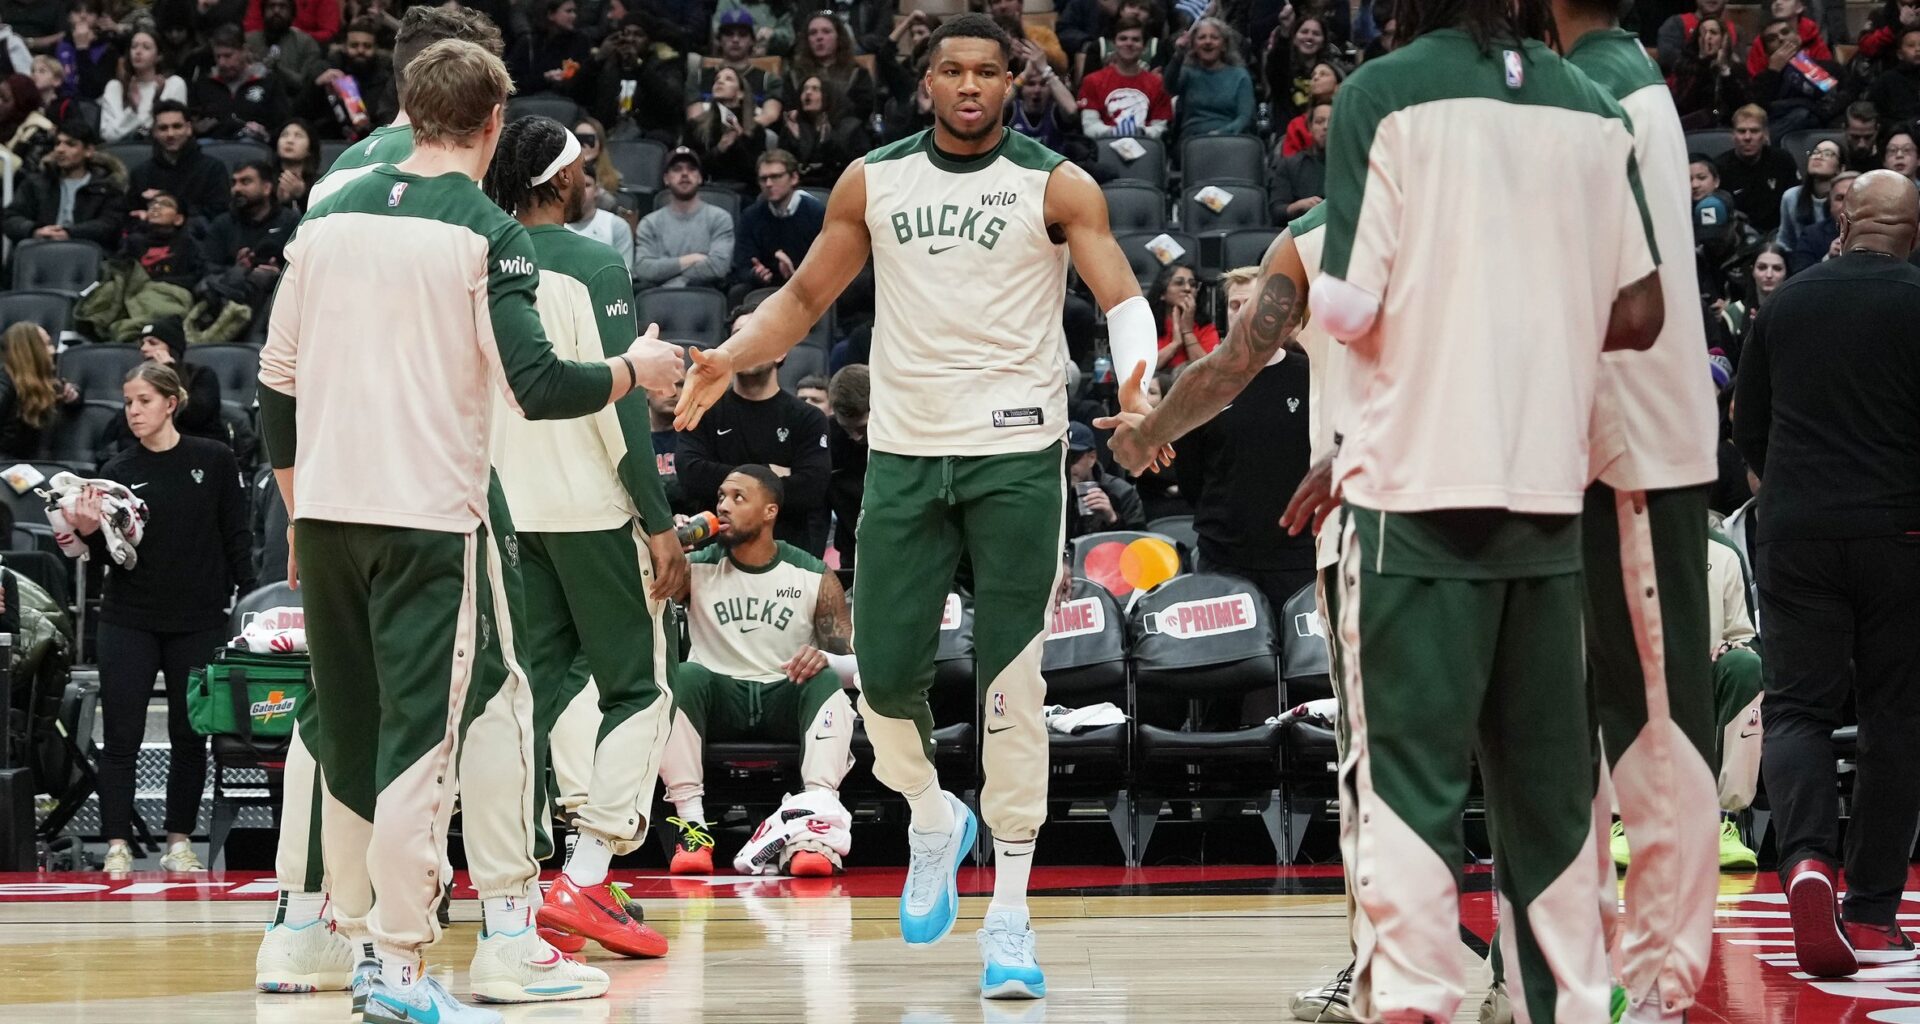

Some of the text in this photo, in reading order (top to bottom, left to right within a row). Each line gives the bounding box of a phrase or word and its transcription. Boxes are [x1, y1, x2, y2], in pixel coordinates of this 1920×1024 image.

[980, 191, 1017, 206] wilo
[891, 204, 1008, 250] BUCKS
[500, 255, 534, 275] wilo
[605, 299, 629, 317] wilo
[776, 586, 802, 599] wilo
[713, 597, 794, 631] BUCKS
[1051, 603, 1095, 634] IME
[1177, 599, 1247, 634] PRIME
[252, 701, 292, 714] Gatorade
